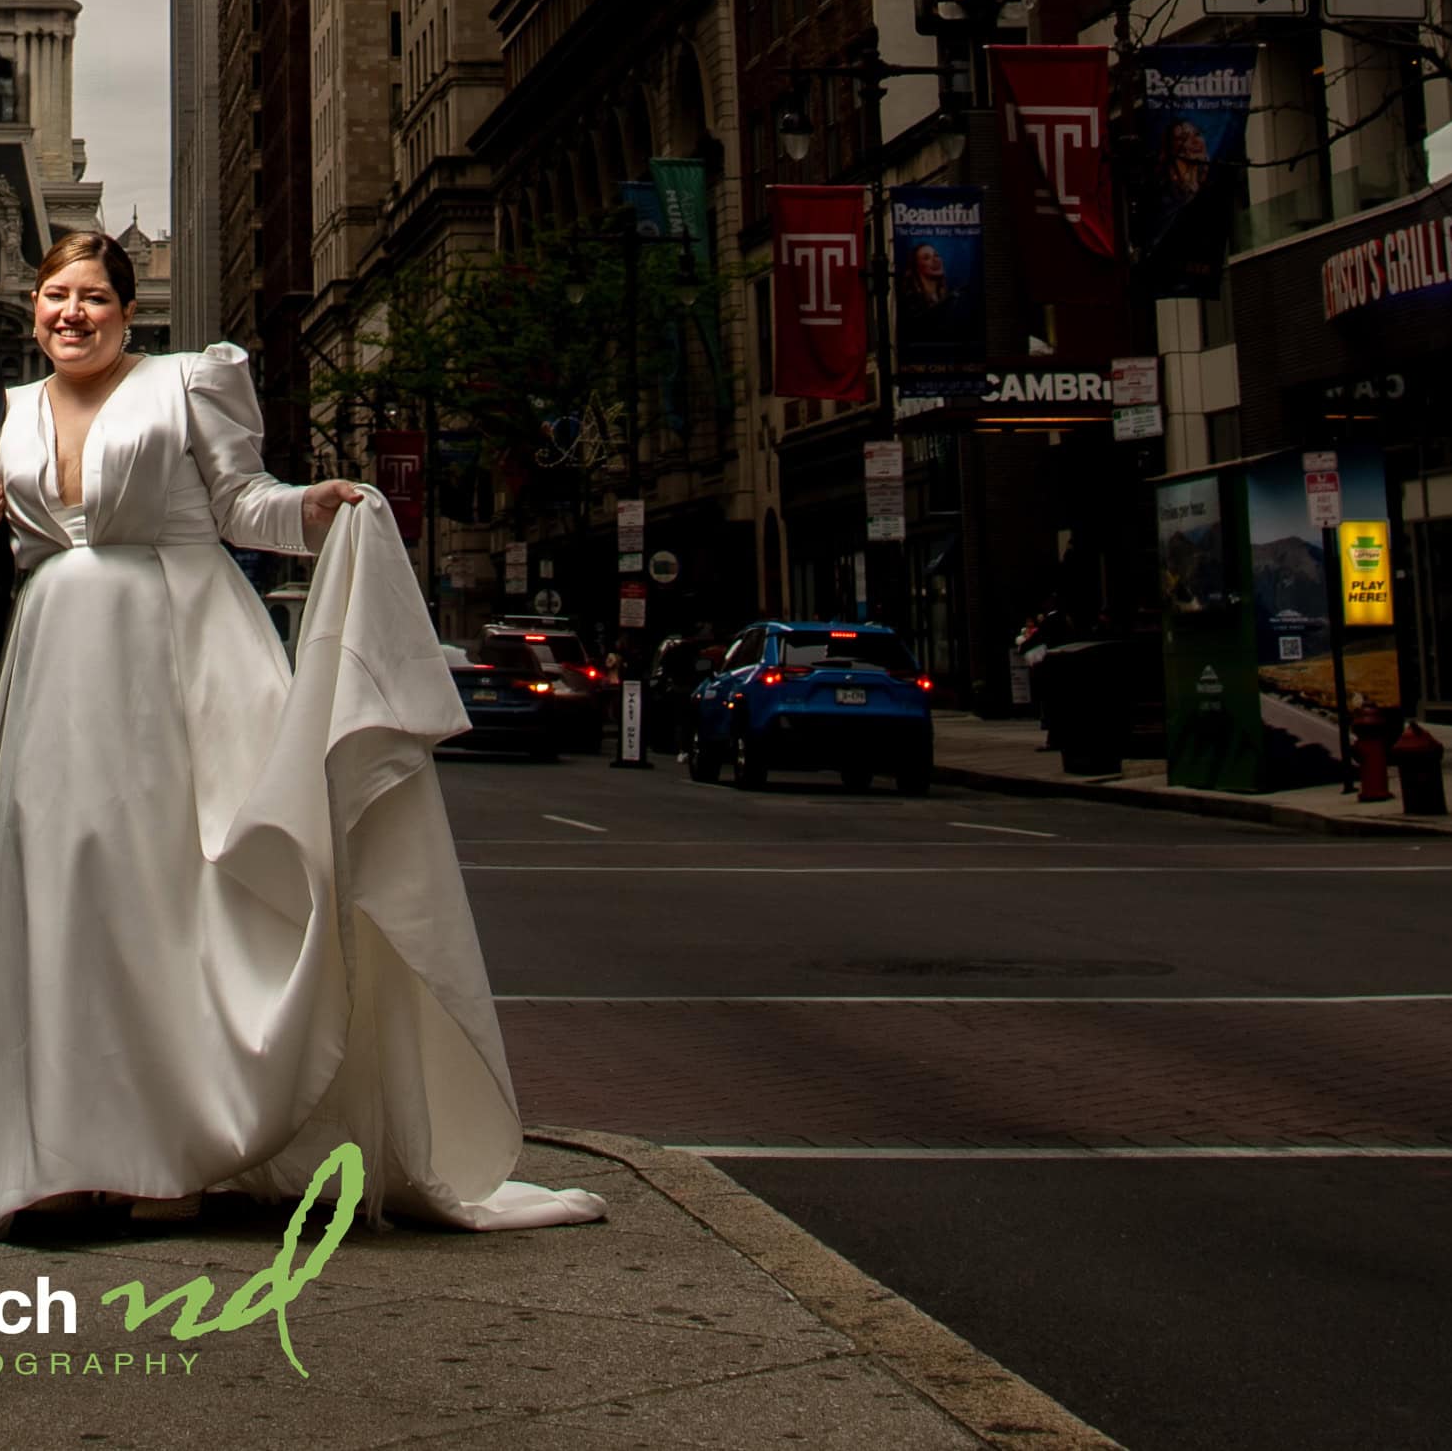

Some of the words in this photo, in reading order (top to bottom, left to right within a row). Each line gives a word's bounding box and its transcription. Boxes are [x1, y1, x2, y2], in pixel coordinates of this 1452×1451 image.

[1145, 67, 1254, 97] Beautiful
[893, 202, 981, 226] Beautiful
[1351, 580, 1385, 591] PLAY
[1348, 591, 1387, 603] HERE!
